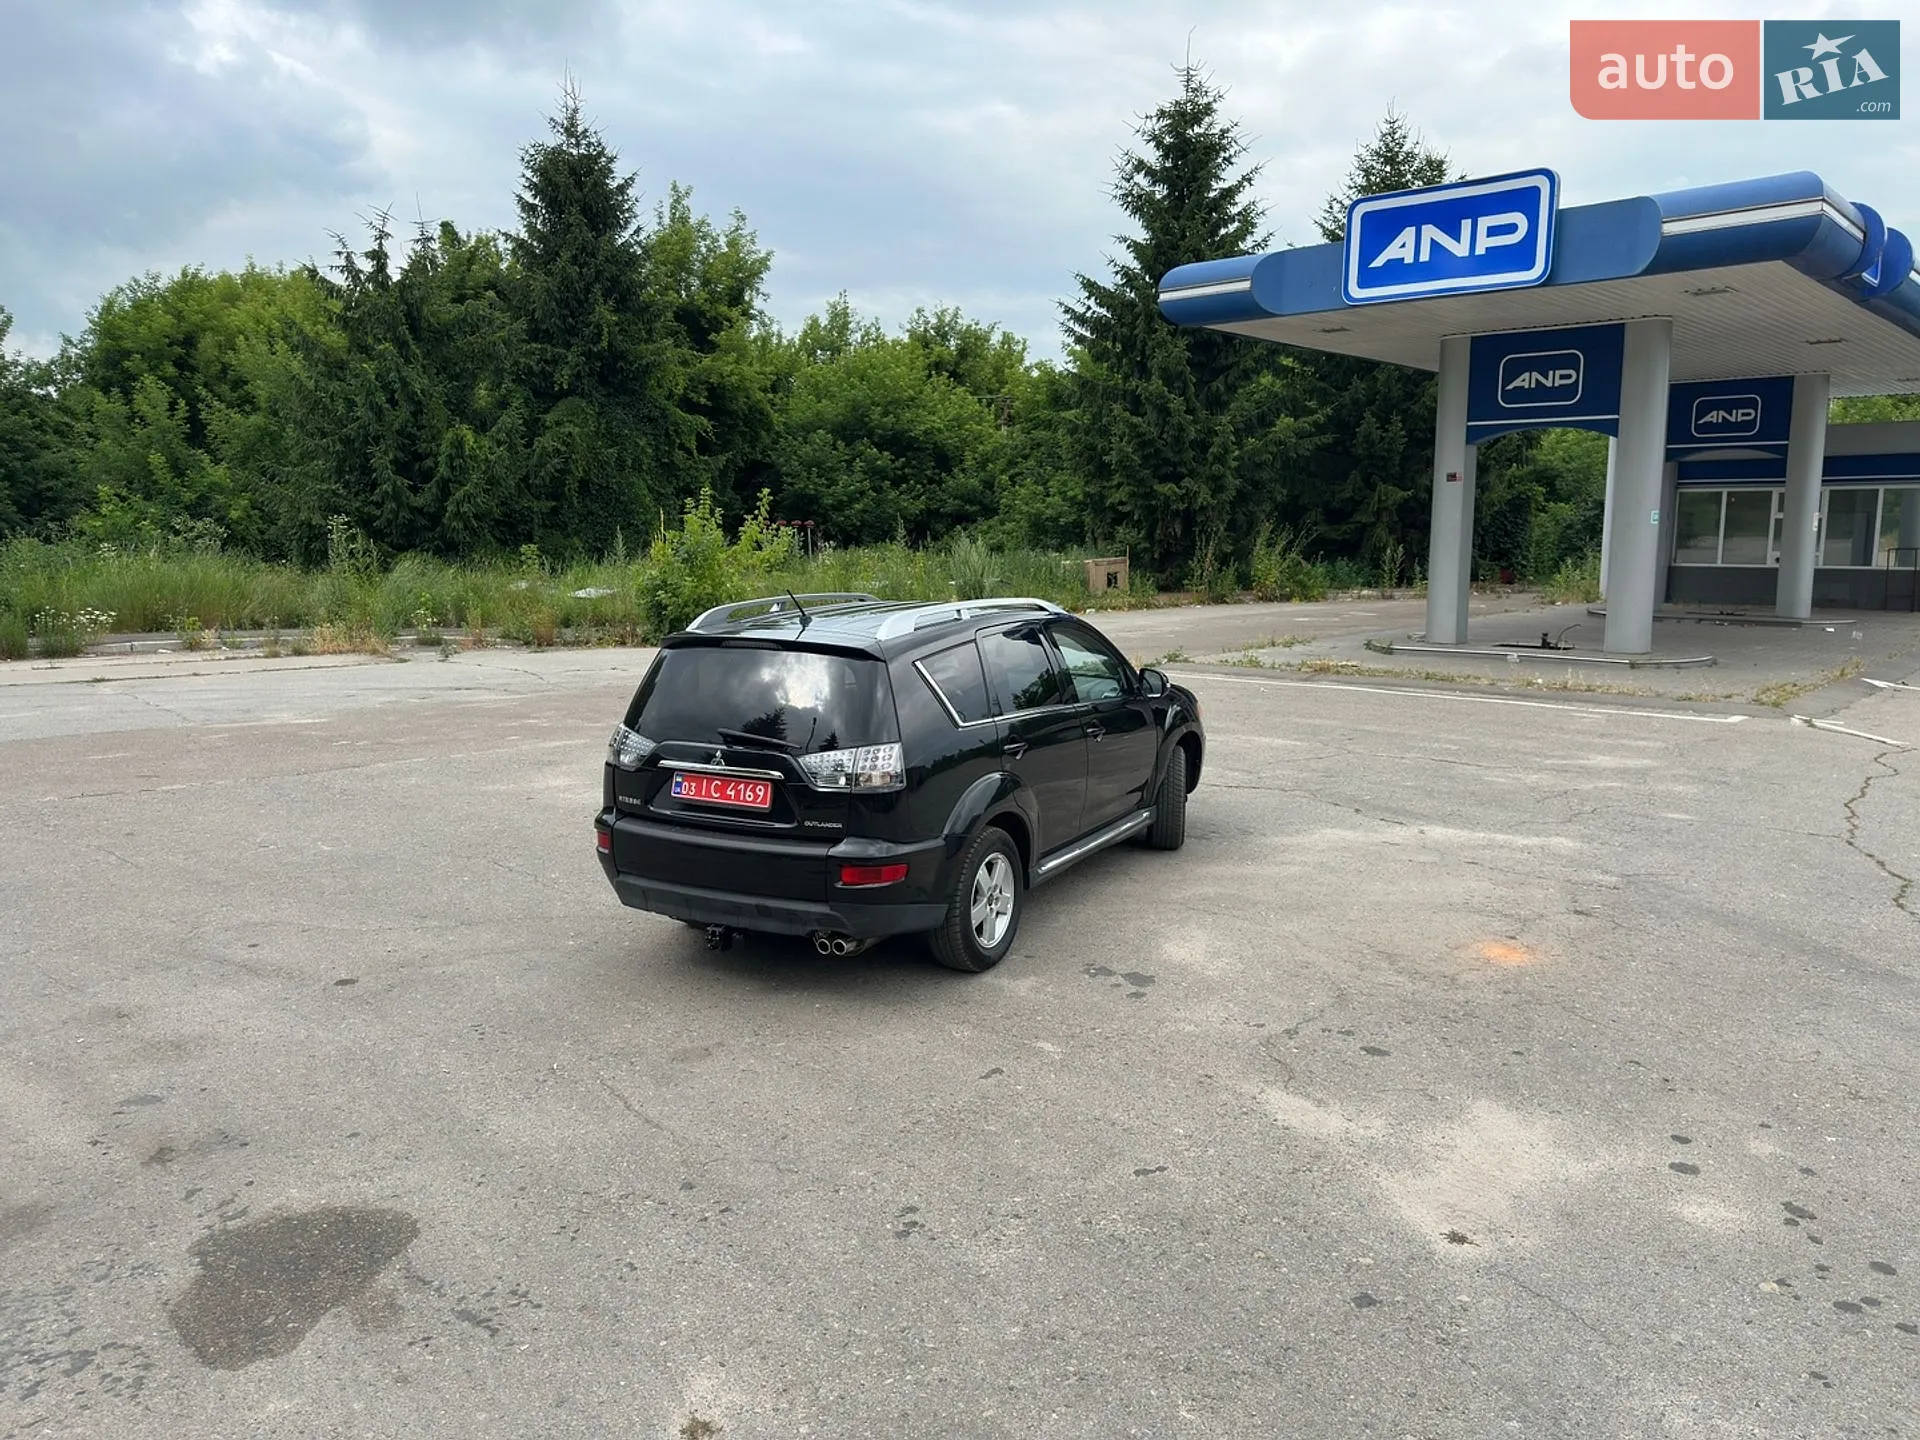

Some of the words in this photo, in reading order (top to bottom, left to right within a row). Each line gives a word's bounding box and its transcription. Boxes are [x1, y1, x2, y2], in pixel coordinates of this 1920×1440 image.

[1367, 211, 1529, 268] ANP
[1503, 368, 1578, 390] ANP
[1697, 408, 1756, 424] ANP
[681, 781, 697, 796] 03
[726, 782, 765, 802] 4169
